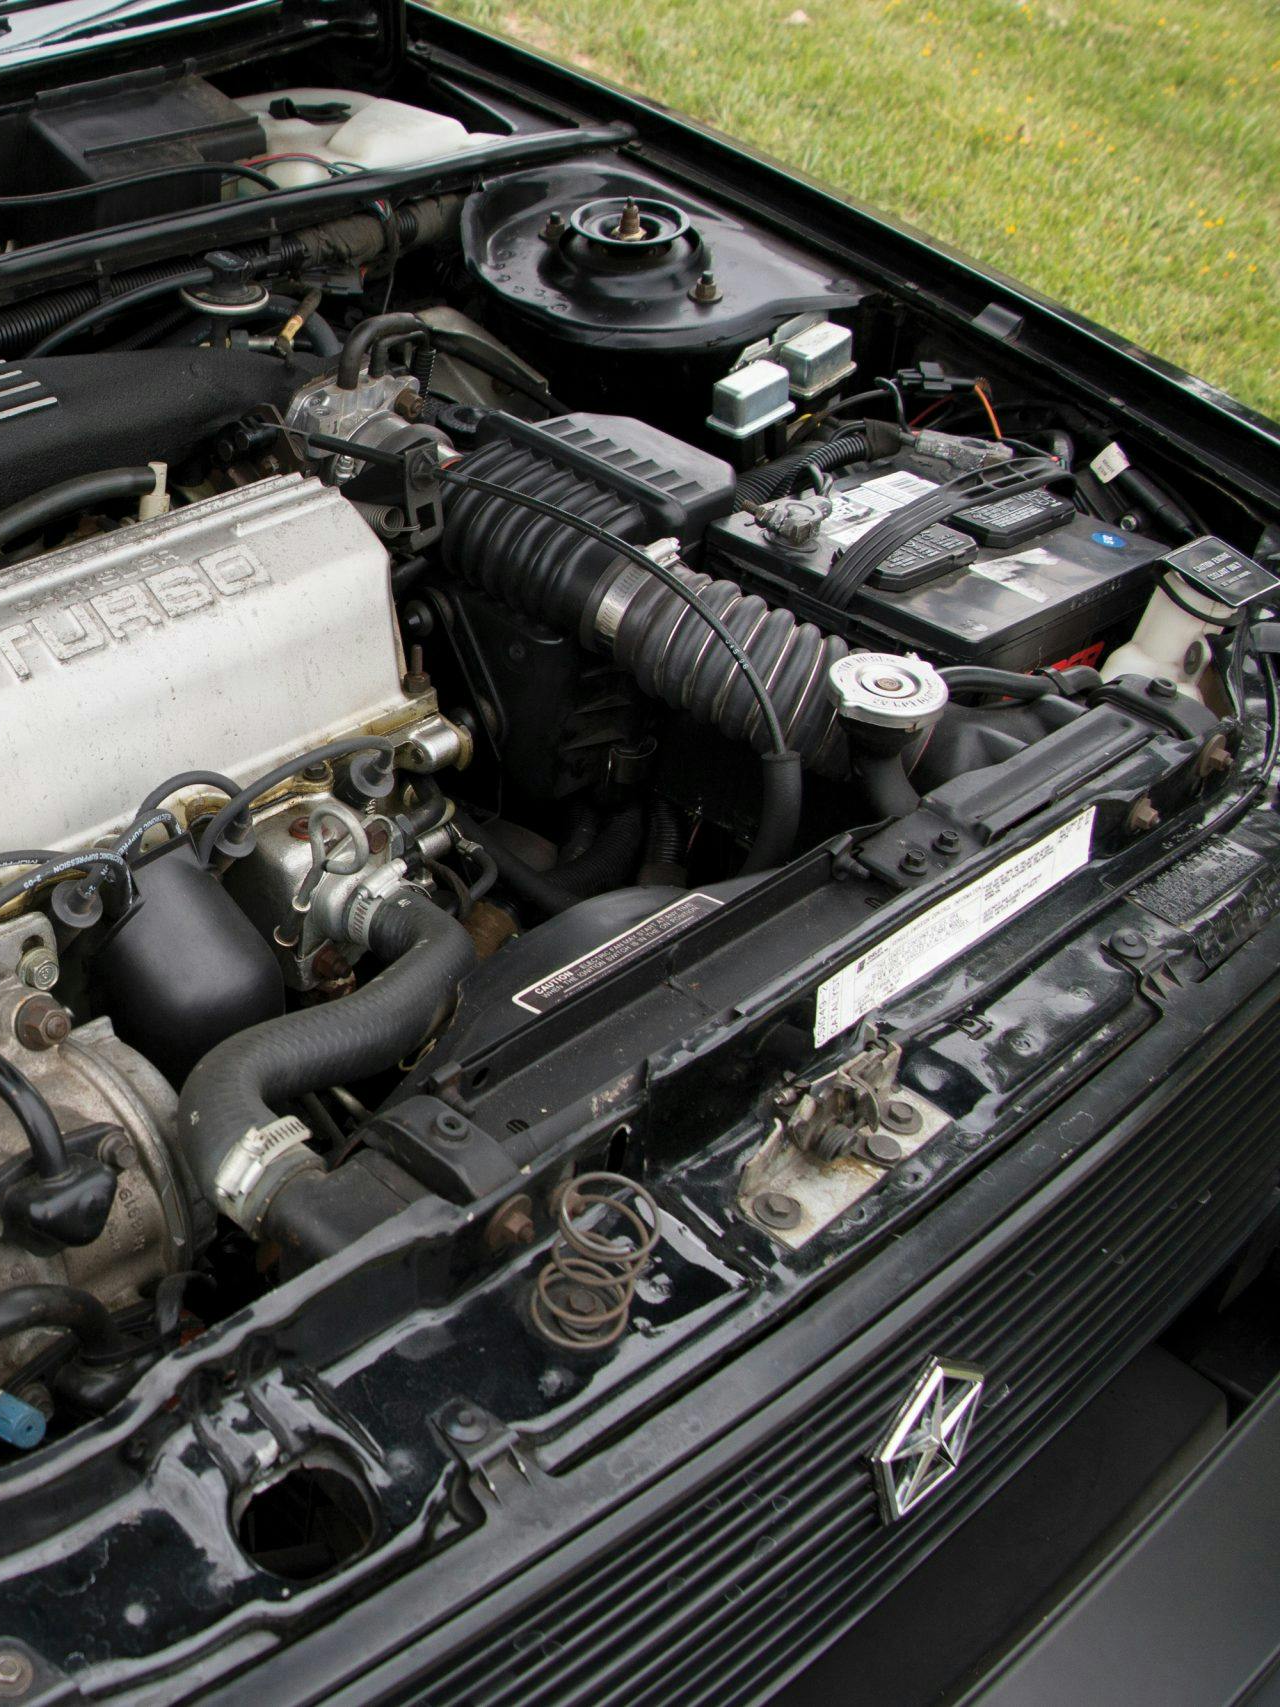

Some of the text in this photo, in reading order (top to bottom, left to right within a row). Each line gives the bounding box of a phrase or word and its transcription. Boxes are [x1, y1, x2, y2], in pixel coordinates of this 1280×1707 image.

[53, 851, 100, 874] SUPPRESSION
[23, 874, 42, 890] 2-05
[534, 970, 574, 996] CAUTION
[542, 983, 564, 999] WHEN
